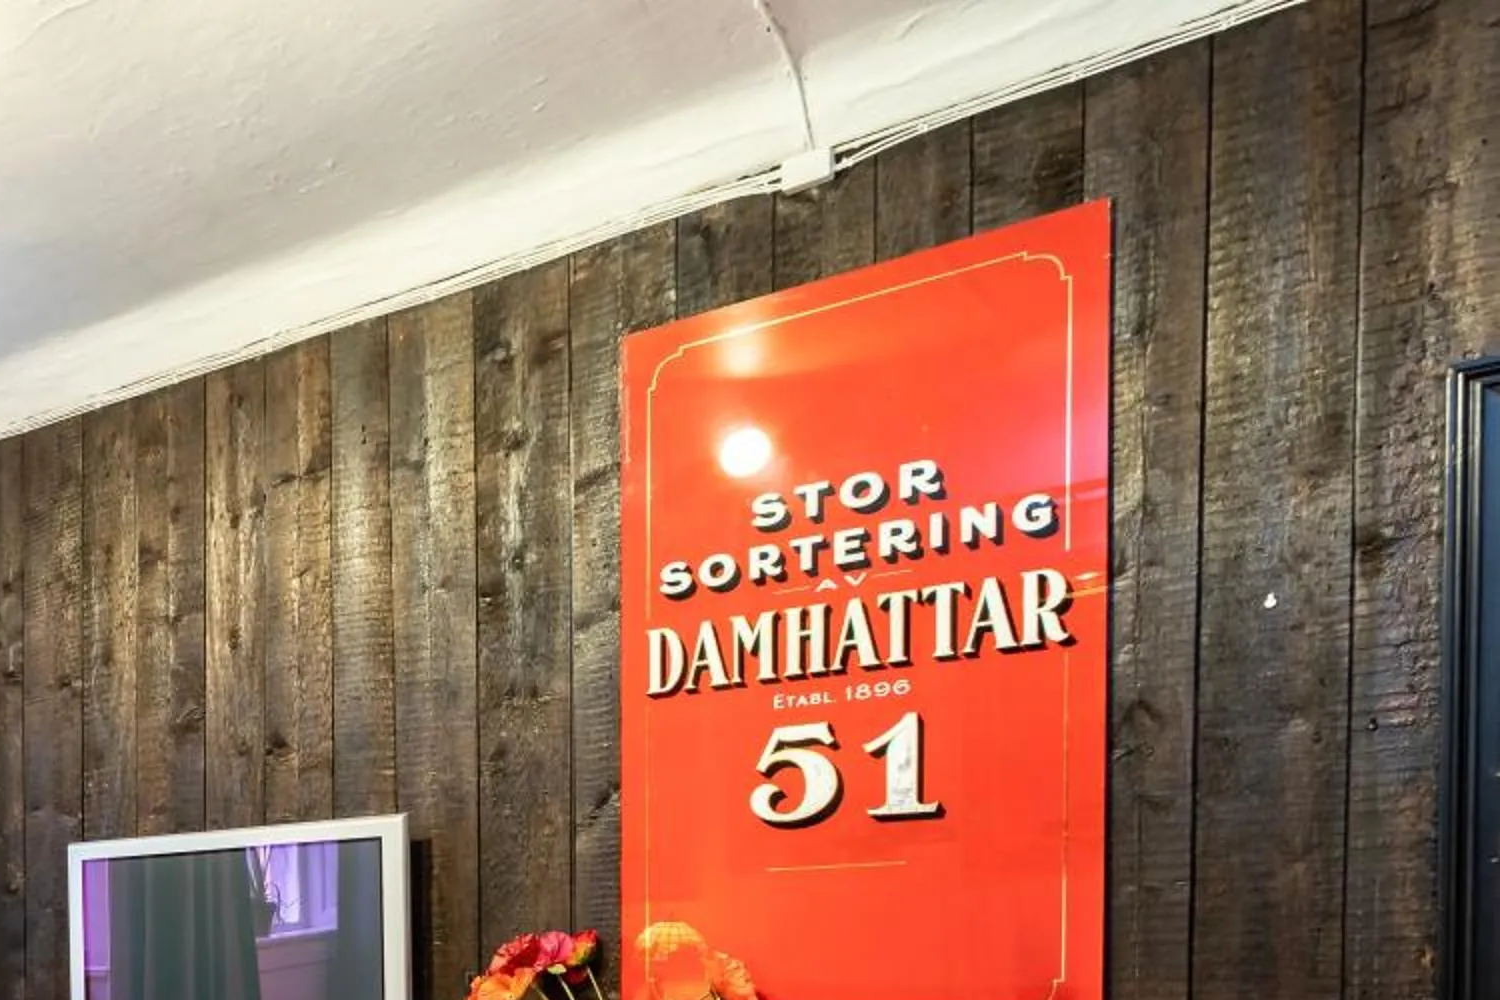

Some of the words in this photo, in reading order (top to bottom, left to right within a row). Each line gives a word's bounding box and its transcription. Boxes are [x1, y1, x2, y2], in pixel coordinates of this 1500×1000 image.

[750, 459, 946, 532] STOR
[659, 493, 1060, 601] SORTERING
[814, 571, 868, 592] AV
[644, 567, 1078, 699] DAMHATTAR
[845, 679, 911, 702] 1896
[749, 711, 946, 830] 51
